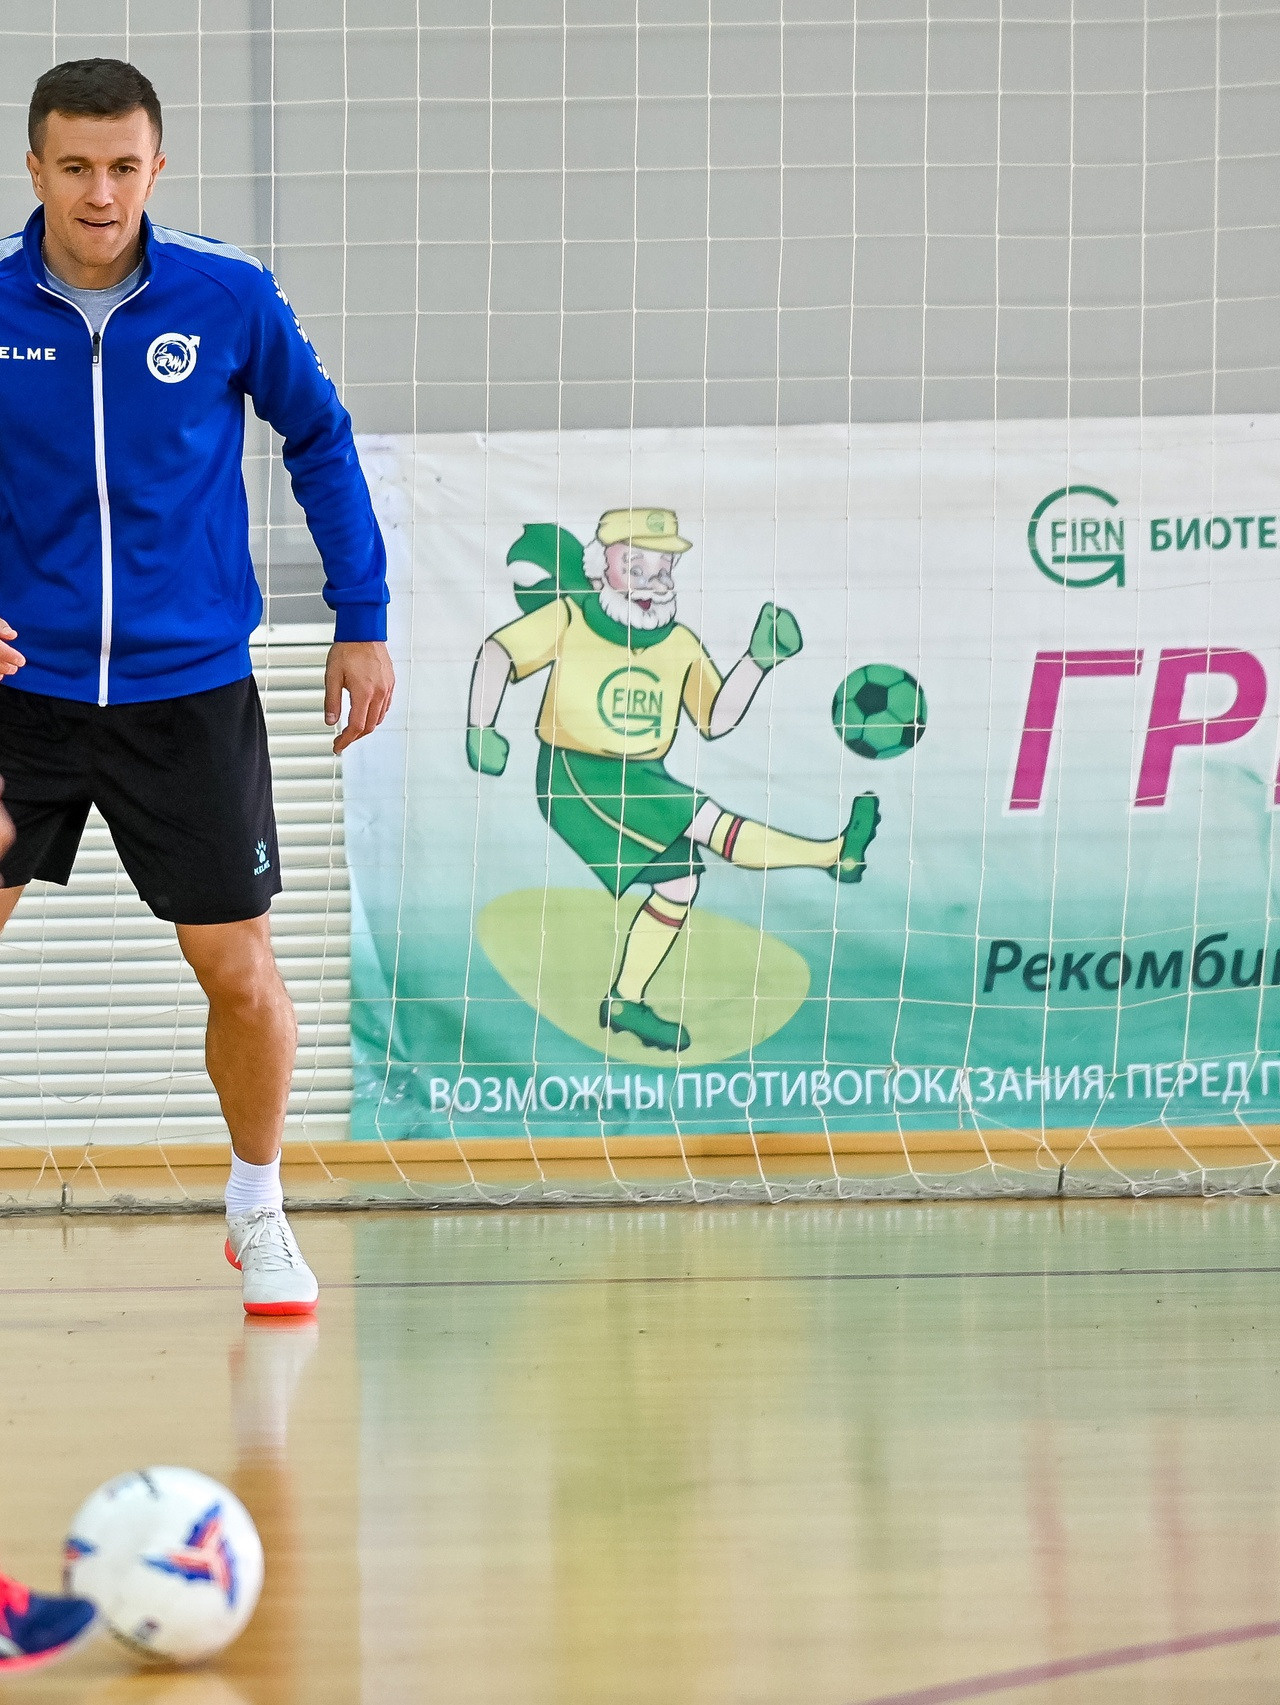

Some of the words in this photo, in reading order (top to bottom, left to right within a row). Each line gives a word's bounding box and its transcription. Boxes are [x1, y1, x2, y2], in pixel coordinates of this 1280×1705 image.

[1050, 518, 1125, 552] FIRN
[612, 688, 663, 714] FIRN
[1008, 647, 1280, 810] ГР
[982, 932, 1280, 993] Рекомби
[429, 1073, 665, 1113] ВОЗМОЖНЫ
[676, 1063, 1116, 1108] ПРОТИВОПОКАЗАНИЯ.
[1126, 1061, 1252, 1104] ПЕРЕД
